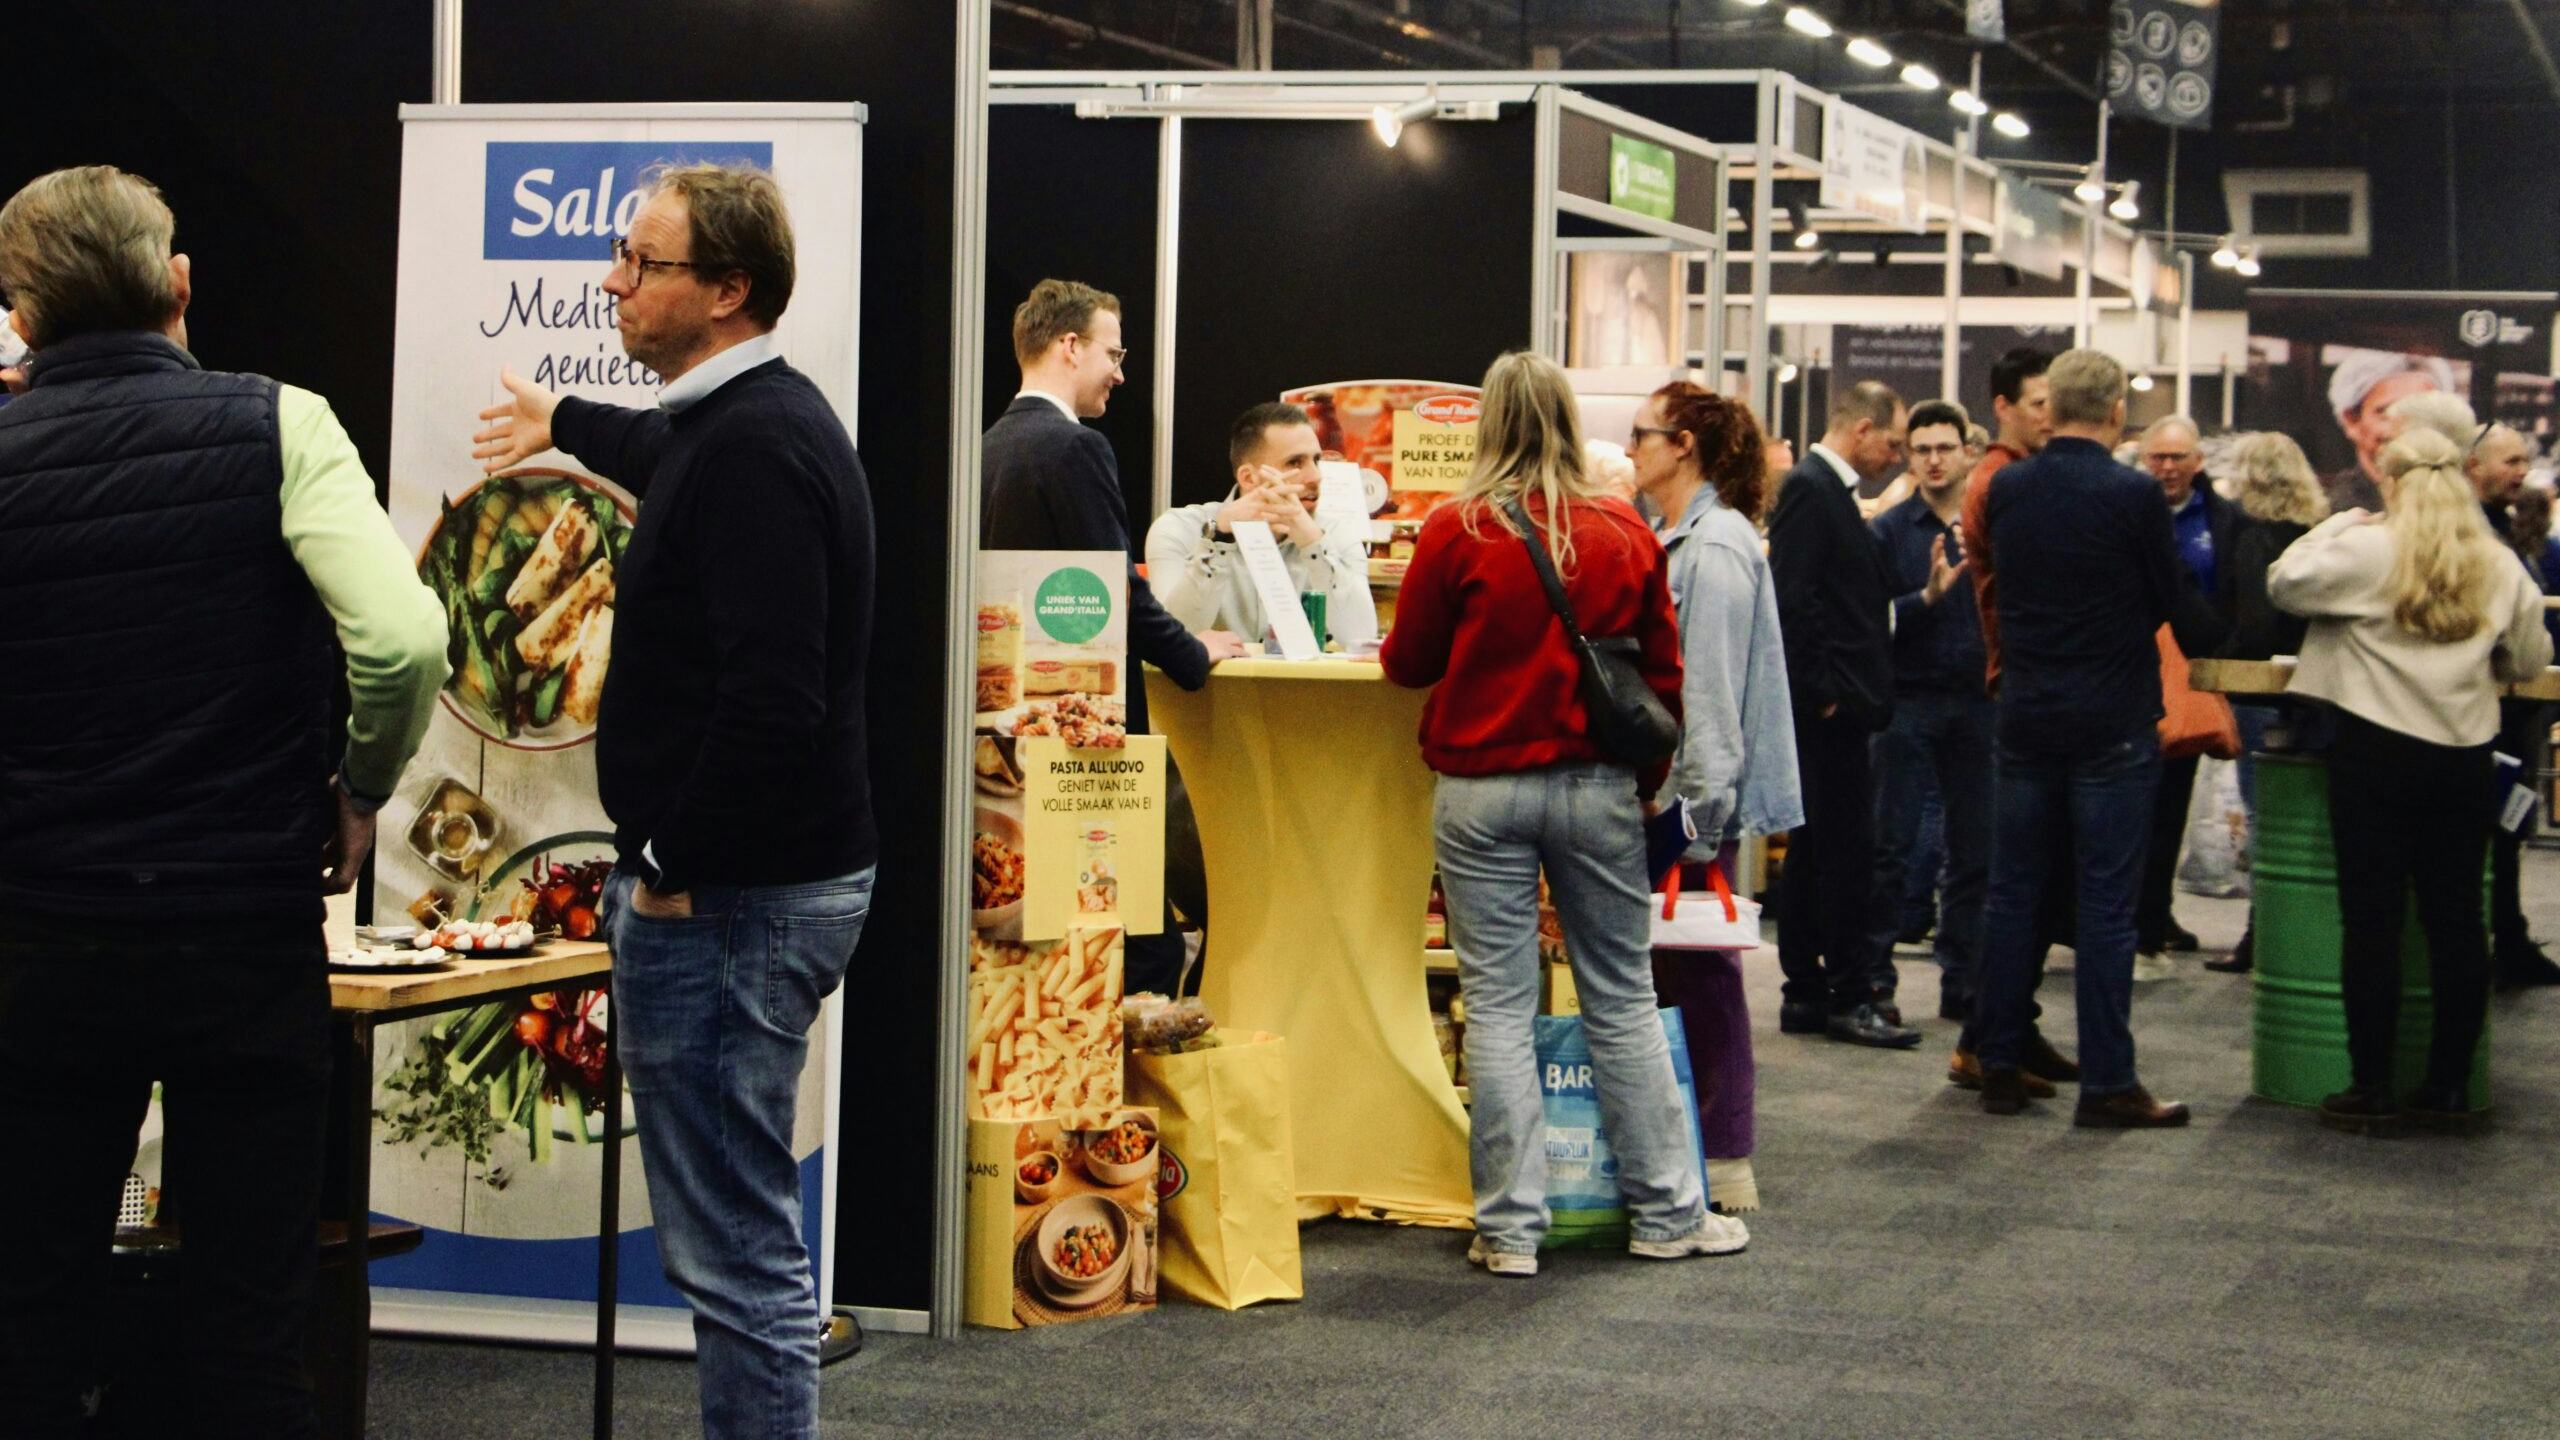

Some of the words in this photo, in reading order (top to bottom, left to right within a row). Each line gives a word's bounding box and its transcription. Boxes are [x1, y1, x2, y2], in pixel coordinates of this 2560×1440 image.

[1419, 433, 1461, 446] PROEF
[1401, 450, 1438, 462] PURE
[1404, 467, 1433, 477] VAN
[1046, 595, 1076, 604] UNIEK
[1078, 595, 1100, 604] VAN
[1038, 605, 1107, 615] GRAND'ITALIA
[1050, 761, 1085, 774] PASTA
[1088, 760, 1145, 774] ALL'UOVO
[1058, 779, 1095, 793] GENIET
[1098, 779, 1121, 792] VAN
[1124, 778, 1137, 792] DE
[1042, 798, 1073, 812] VOLLE
[1076, 798, 1115, 811] SMAAK
[1118, 797, 1140, 810] VAN
[1143, 796, 1152, 810] EI
[1545, 1063, 1594, 1089] BAR
